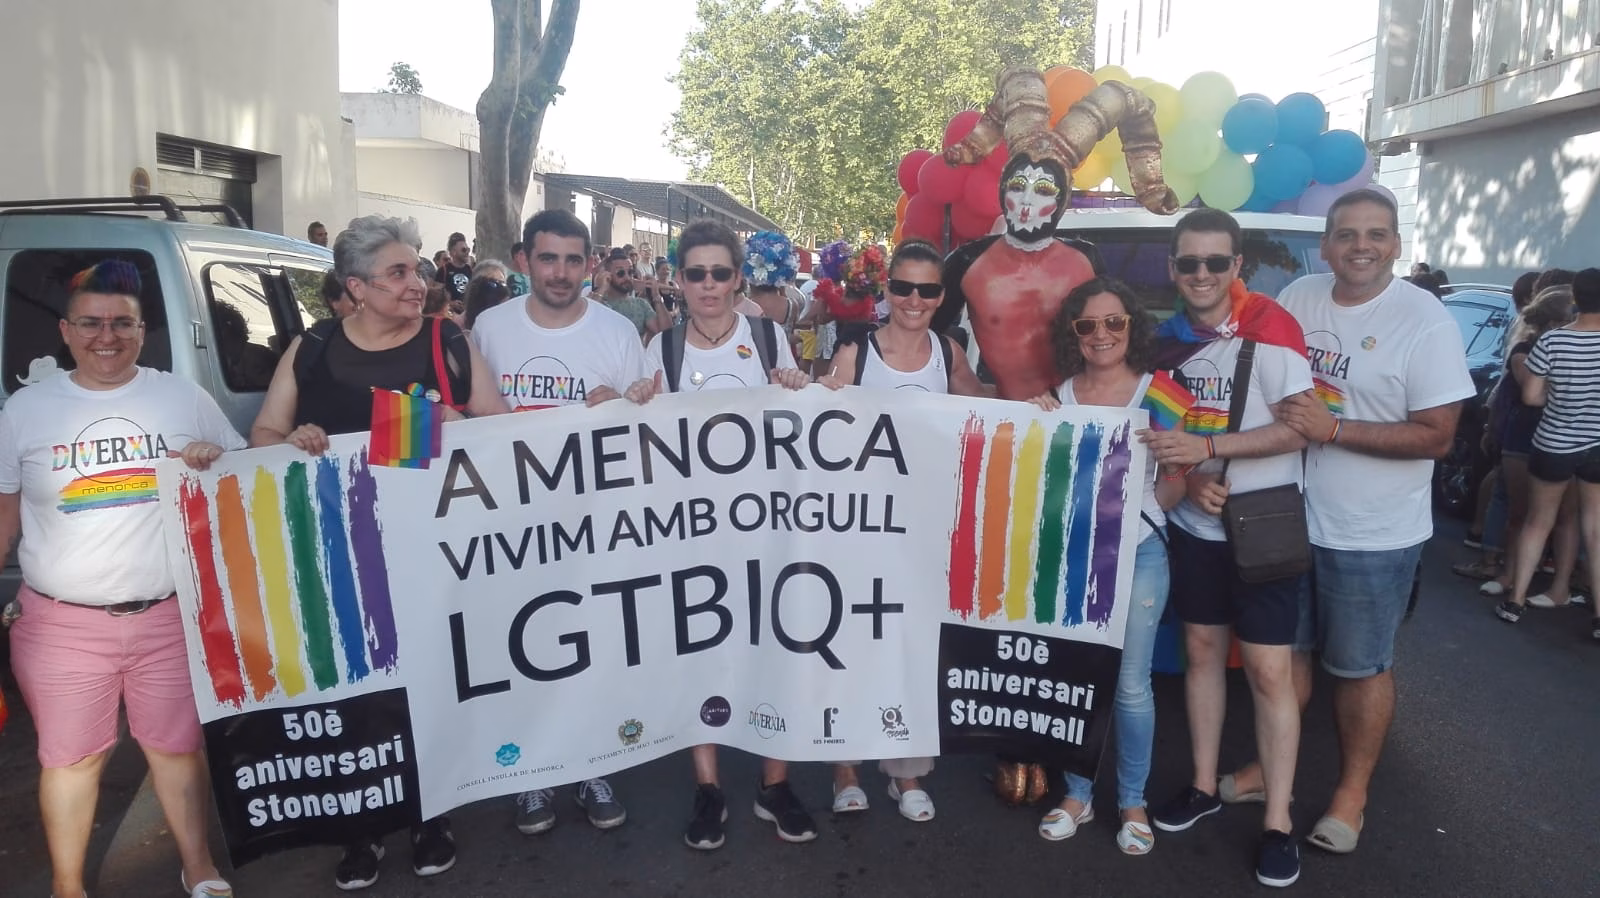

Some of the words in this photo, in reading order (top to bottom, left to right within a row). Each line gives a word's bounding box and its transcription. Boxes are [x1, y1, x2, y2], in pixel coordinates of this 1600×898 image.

[501, 374, 587, 401] DIVERXIA
[51, 433, 168, 472] DIVERXIA
[435, 448, 498, 518] A
[513, 409, 909, 505] MENORCA
[82, 481, 149, 494] menorca
[438, 515, 595, 580] VIVIM
[607, 497, 718, 551] AMB
[729, 491, 907, 534] ORGULL
[449, 558, 904, 703] LGTBIQ+
[998, 635, 1050, 665] 50è
[947, 667, 1095, 711] aniversari
[282, 709, 343, 741] 50è
[748, 710, 786, 733] DIVERXIA
[950, 698, 1085, 746] Stonewall
[235, 734, 404, 790] aniversari
[456, 777, 487, 791] CONSELL
[488, 771, 518, 782] INSULAR
[531, 764, 564, 774] MENORCA
[248, 775, 404, 827] Stonewall
